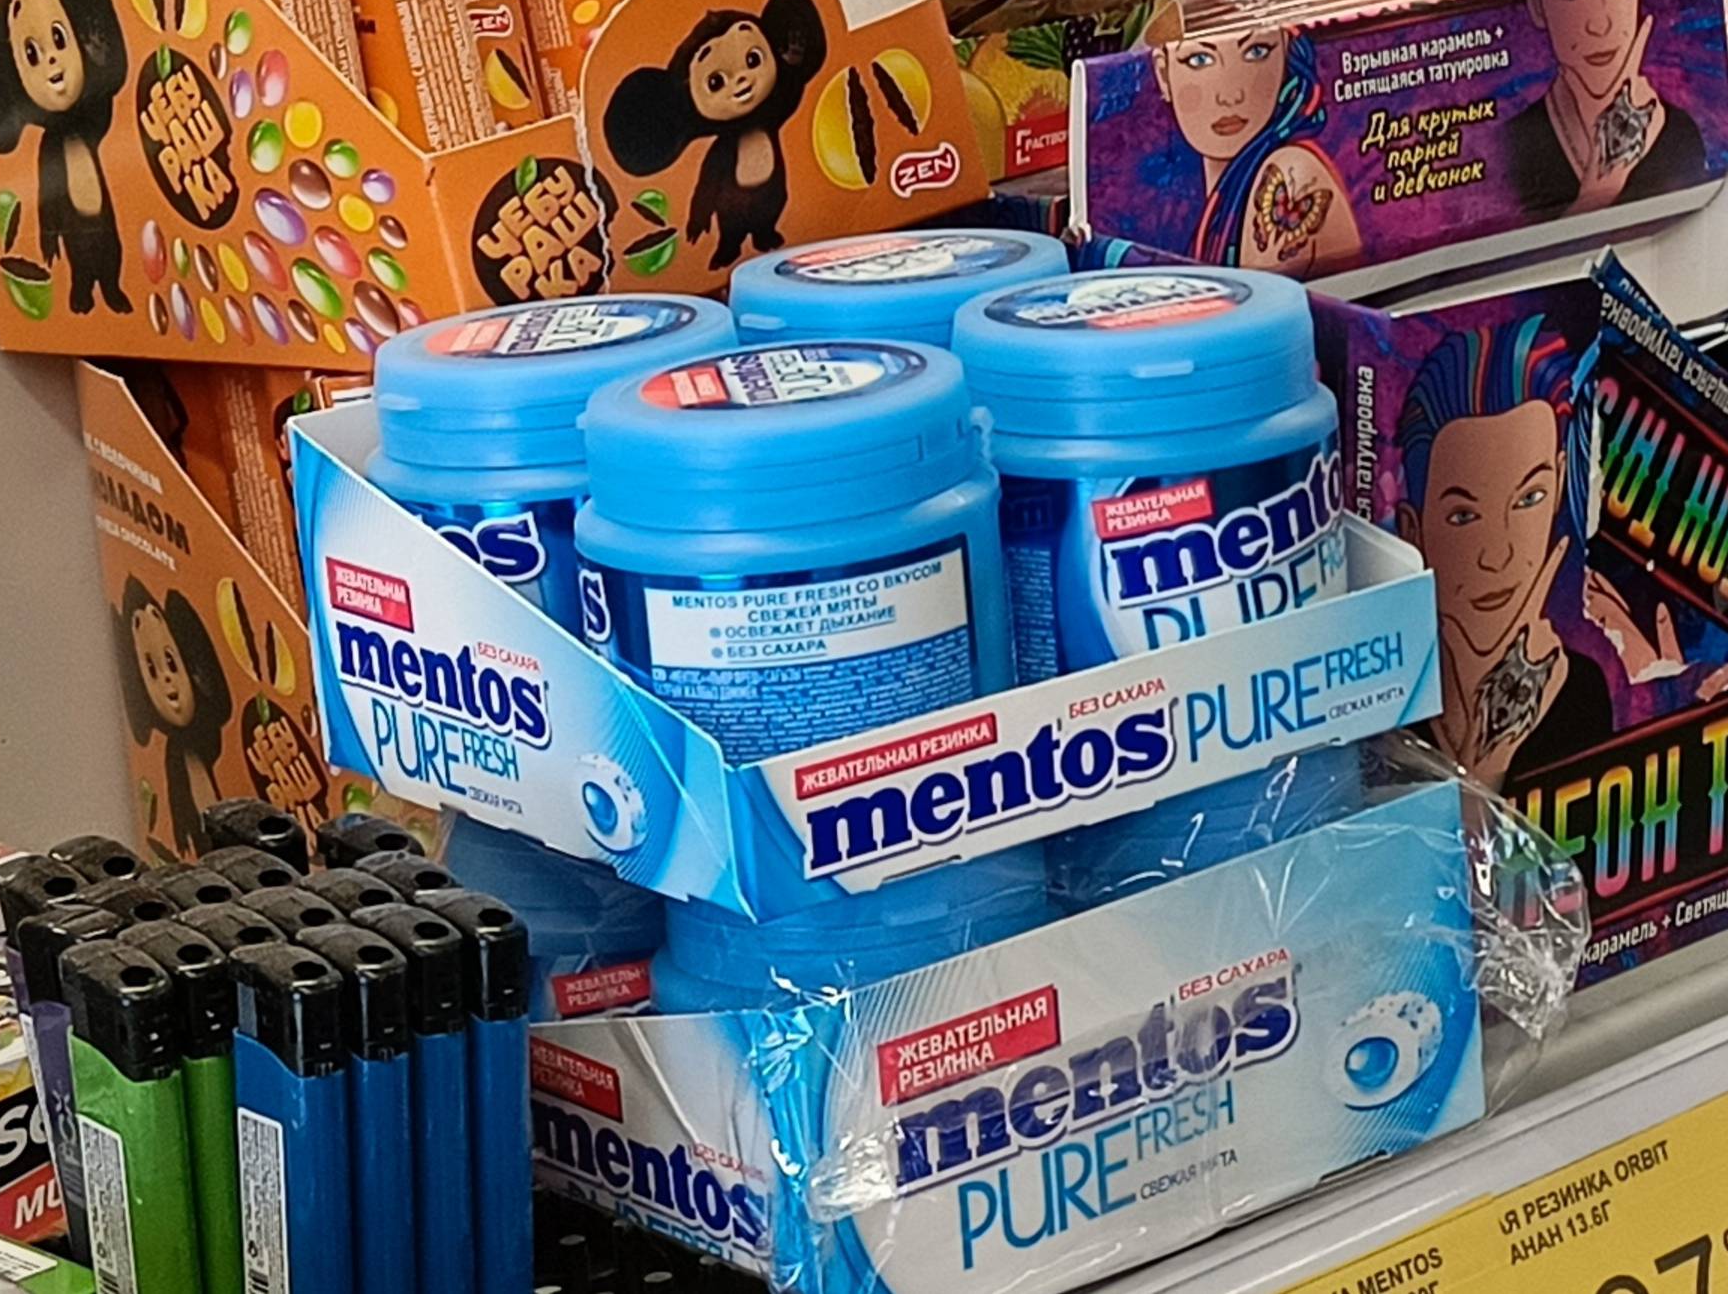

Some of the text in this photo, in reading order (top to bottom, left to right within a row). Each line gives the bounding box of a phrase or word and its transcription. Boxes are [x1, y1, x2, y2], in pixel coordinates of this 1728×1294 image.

[1333, 47, 1510, 103] Светящаяся татуировка
[1341, 28, 1492, 76] Взрывная карамель
[1361, 98, 1497, 151] Для крутых
[1386, 132, 1461, 170] парней
[1392, 161, 1485, 203] девчонок
[1102, 483, 1207, 519] ЖЕВАТЕЛЬНАЯ
[1106, 507, 1172, 531] РЕЗИНКА
[672, 561, 942, 609] MENTOS PURE FRESH СО ВКУСОМ
[748, 595, 878, 623] СВЕЖЕЙ МЯТЫ
[724, 605, 896, 639] ОСВЕЖАЕТ ДЫХАНИЕ
[727, 640, 827, 659] БЕЗ САХАРА
[335, 620, 552, 750] mentos
[1068, 678, 1167, 720] БЕЗ САХАРА
[1186, 632, 1404, 764] PURE FRESH
[373, 703, 520, 795] PURE FRESH
[800, 719, 993, 798] ЖЕВАТЕЛЬНАЯ РЕЗИНКА
[805, 701, 1178, 882] mentos
[1178, 949, 1290, 1002] БЕЗ САХАРА
[895, 997, 1049, 1067] ЖЕВАТЕЛЬНАЯ
[894, 974, 1302, 1198] mentos
[897, 1044, 995, 1093] РЕЗИНКА
[1134, 1082, 1237, 1162] FRESH
[957, 1119, 1137, 1271] PURE
[1523, 1140, 1670, 1227] РЕЗИНКА ORBIT
[1356, 1247, 1444, 1294] MENTOS
